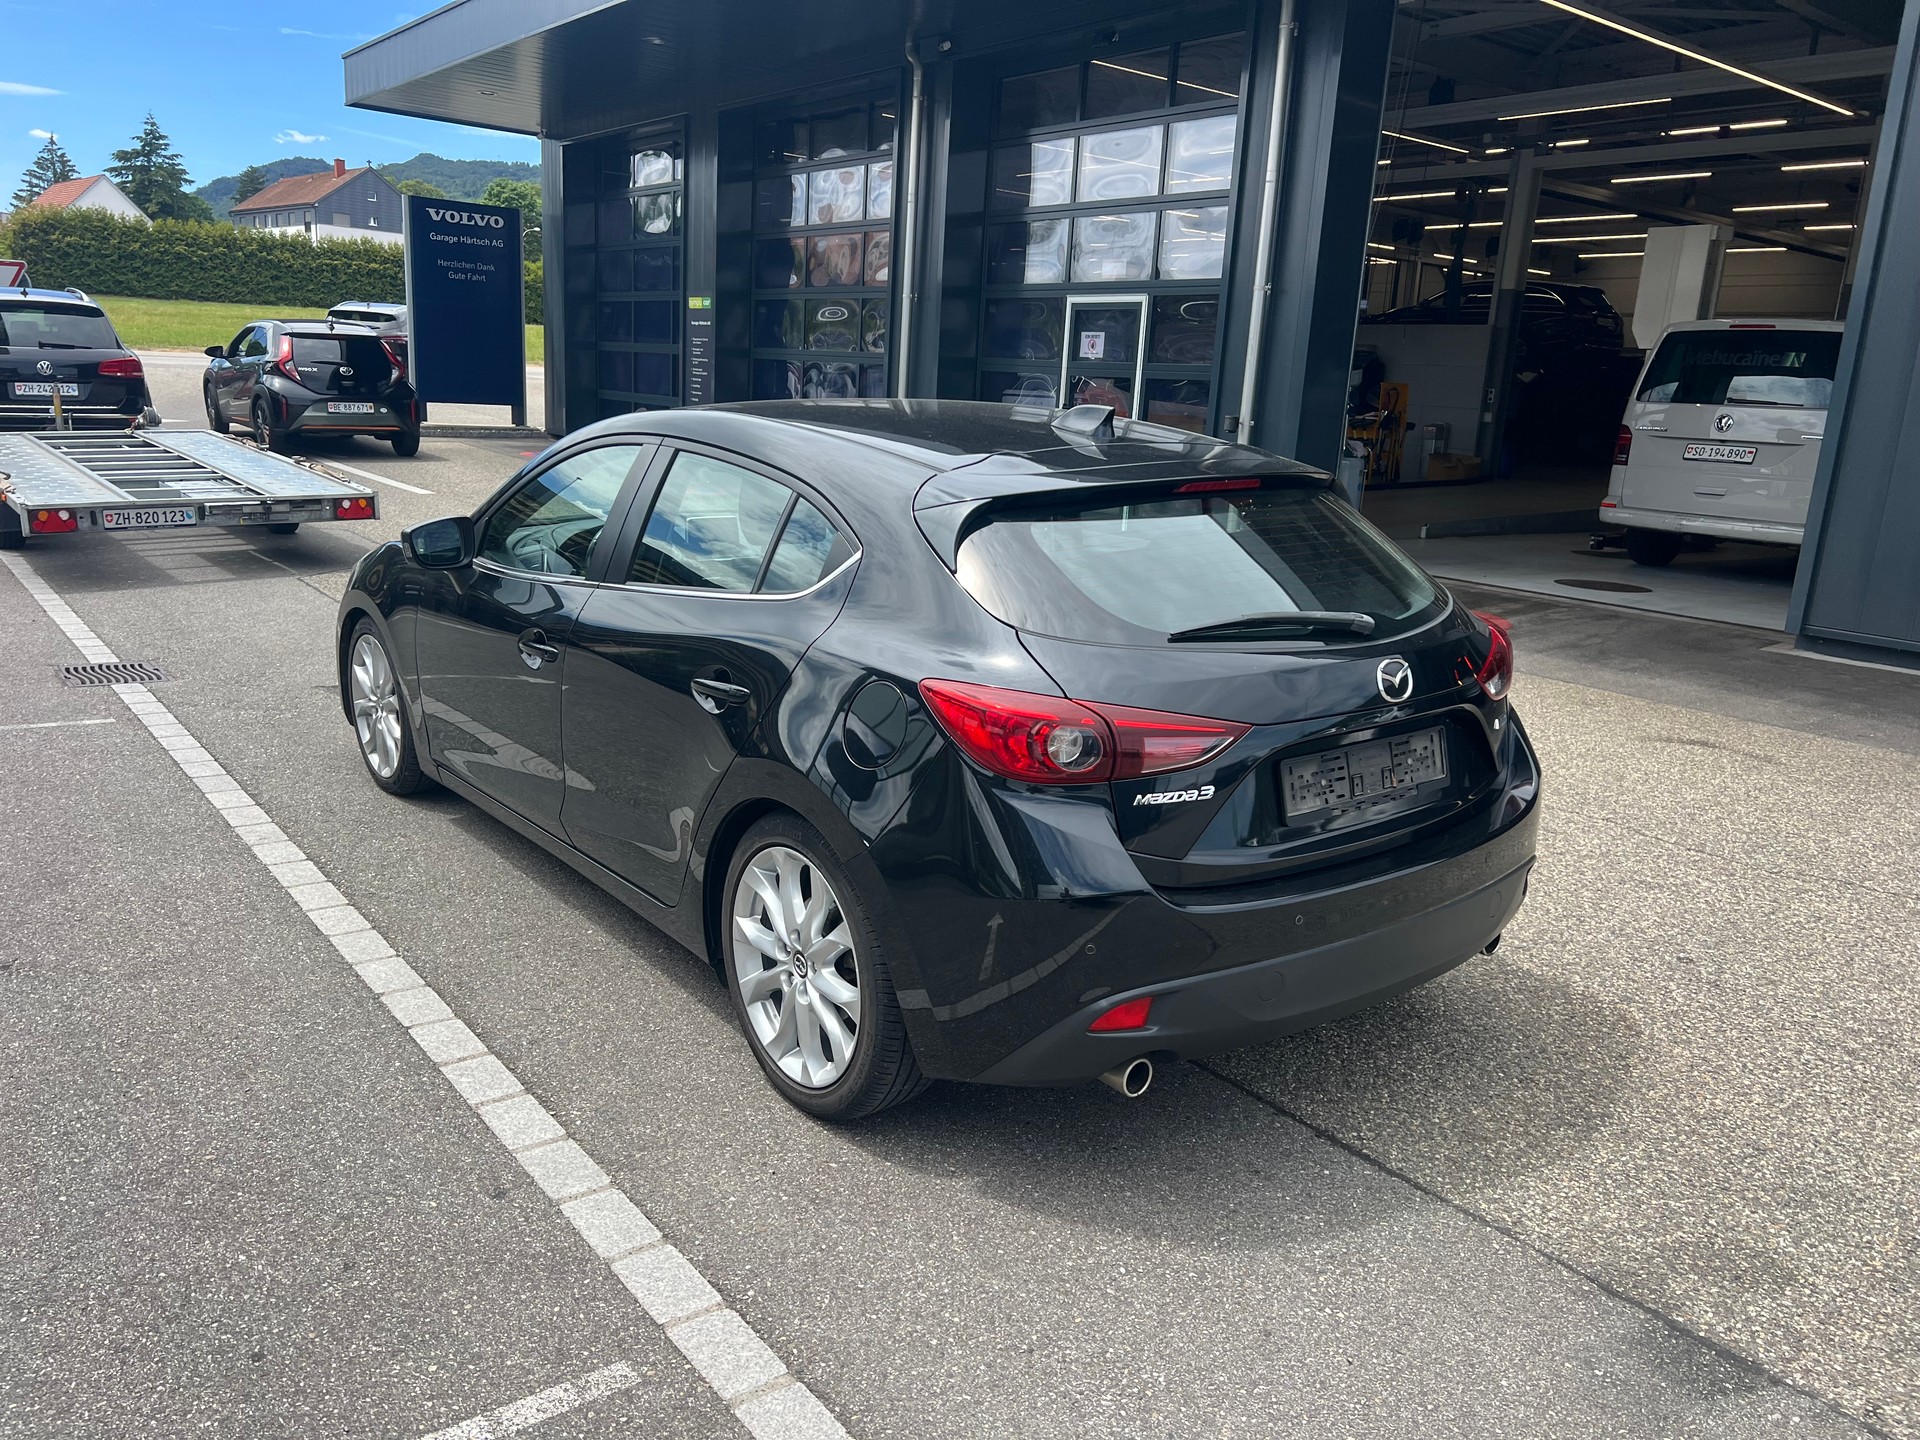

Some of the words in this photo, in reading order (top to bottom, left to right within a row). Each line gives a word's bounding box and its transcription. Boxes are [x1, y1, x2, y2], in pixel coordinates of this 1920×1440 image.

[425, 207, 505, 229] VOLVO
[429, 232, 459, 244] Garage
[460, 235, 490, 247] Härtsch
[491, 239, 504, 248] AG
[437, 258, 476, 270] Herzlichen
[476, 262, 496, 272] Dank
[448, 271, 466, 280] Gute
[467, 273, 487, 282] Fahrt
